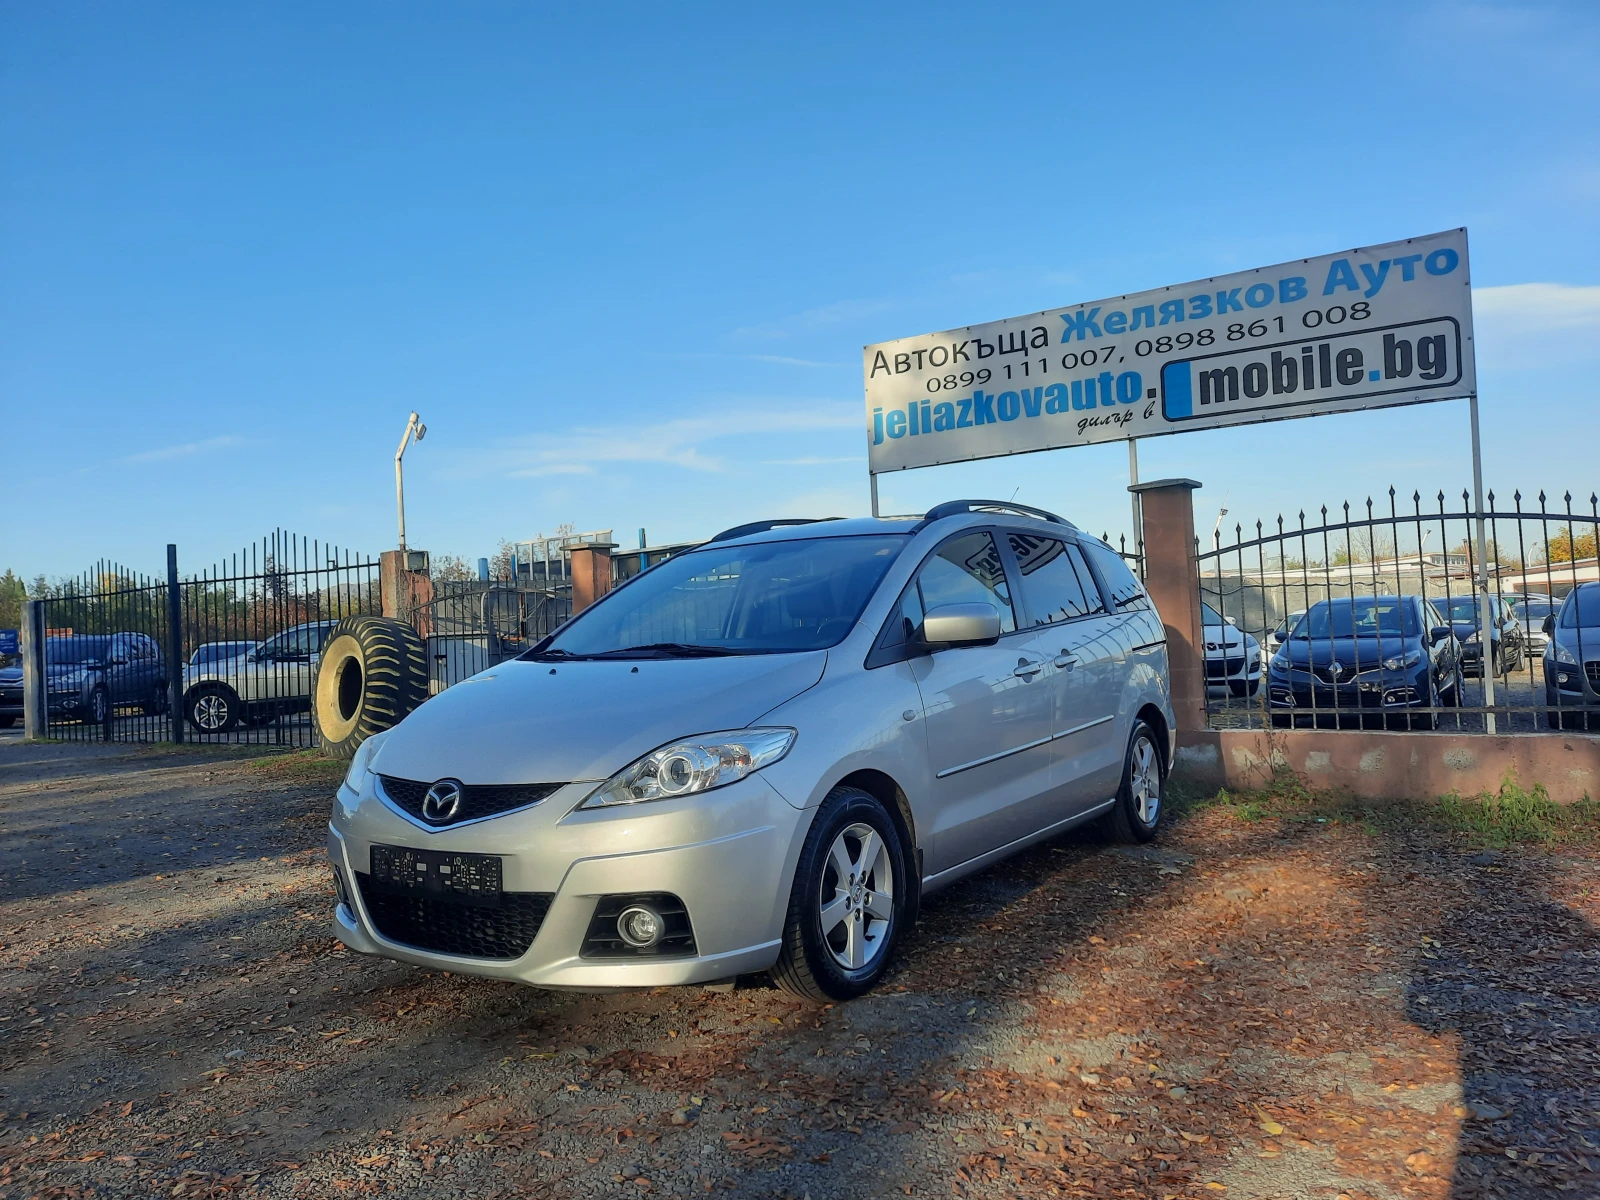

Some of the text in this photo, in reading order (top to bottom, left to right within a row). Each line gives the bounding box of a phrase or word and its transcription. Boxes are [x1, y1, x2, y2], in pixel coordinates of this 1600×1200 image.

[869, 248, 1460, 379] Автокъща Желязков Ауто
[926, 301, 1371, 393] 0899 111 007, 0898 861 008
[1199, 333, 1447, 405] mobile.bg
